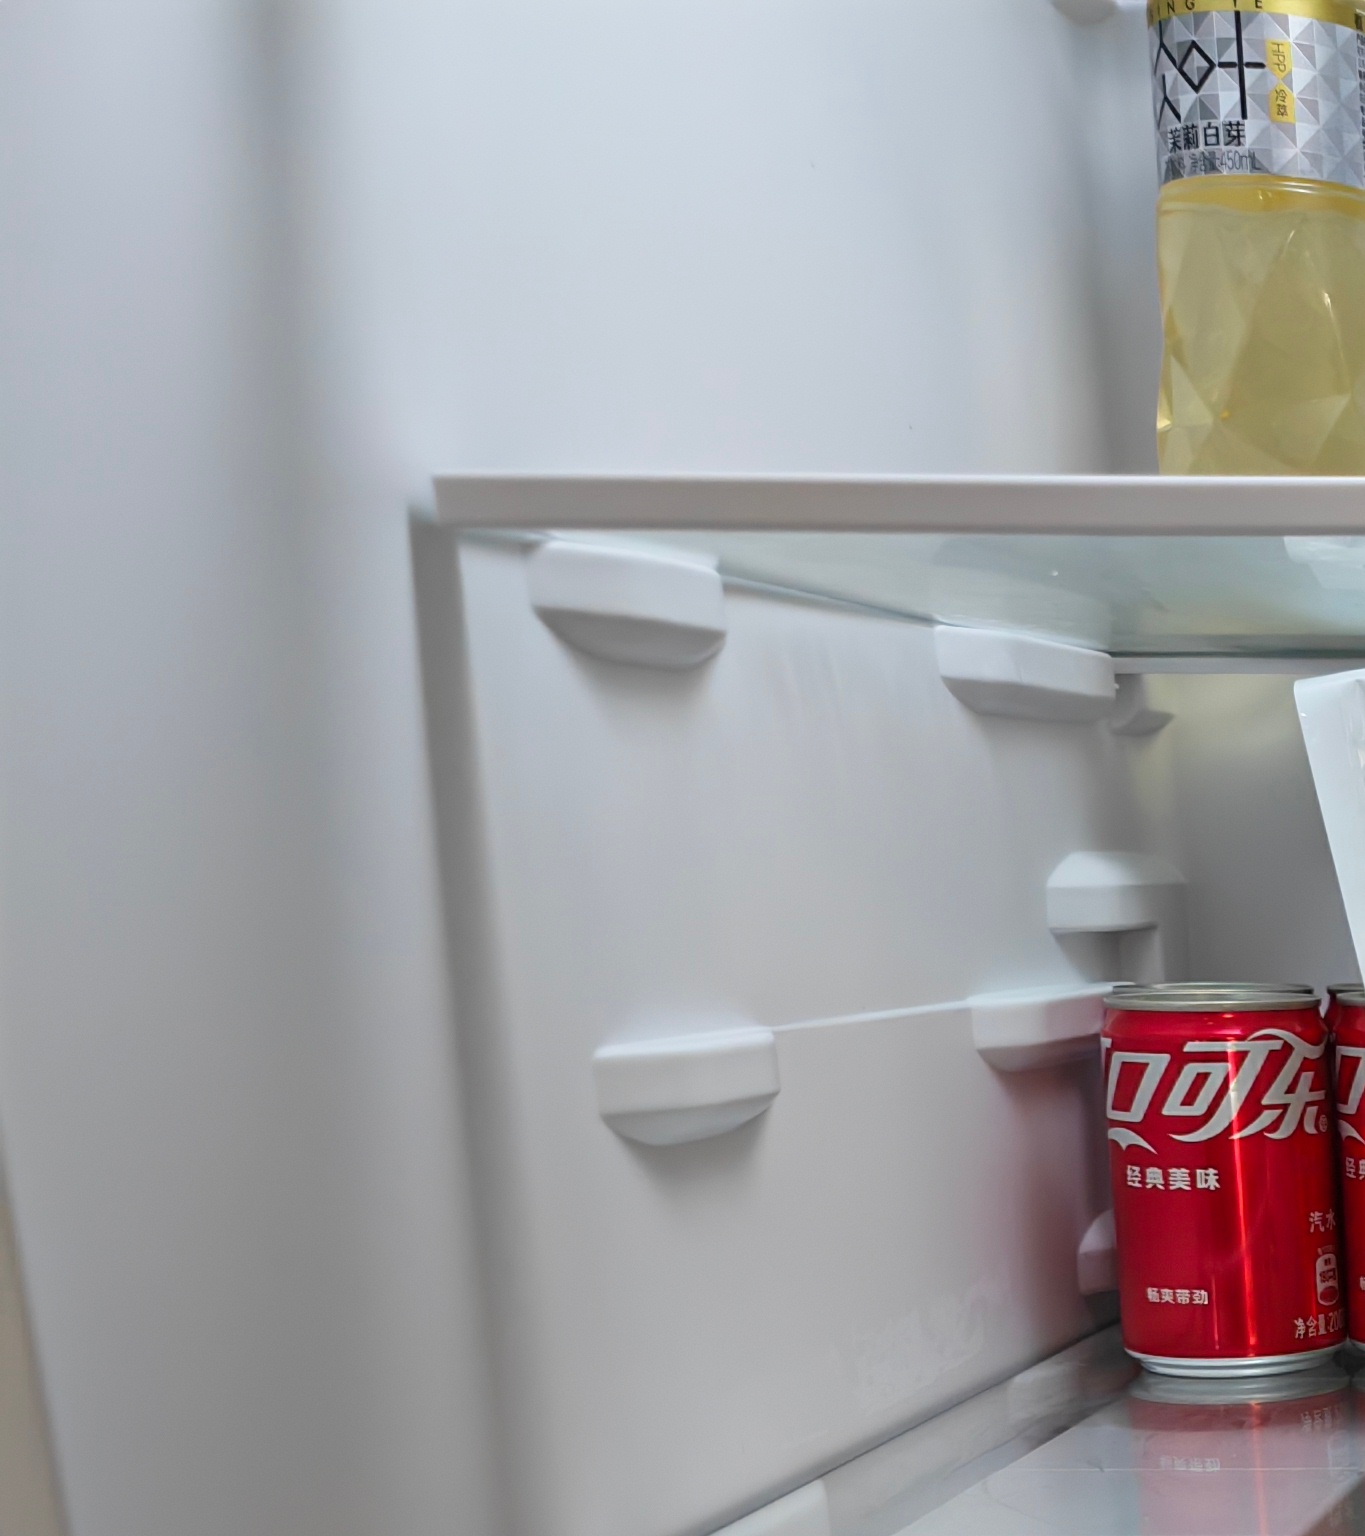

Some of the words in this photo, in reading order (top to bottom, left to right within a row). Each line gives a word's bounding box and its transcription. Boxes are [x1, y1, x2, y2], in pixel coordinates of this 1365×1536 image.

[1167, 119, 1247, 153] 茉莉白芽
[1126, 1164, 1221, 1191] 经典美味
[1308, 1208, 1336, 1233] 汽水
[1146, 1287, 1209, 1305] 畅爽带劲
